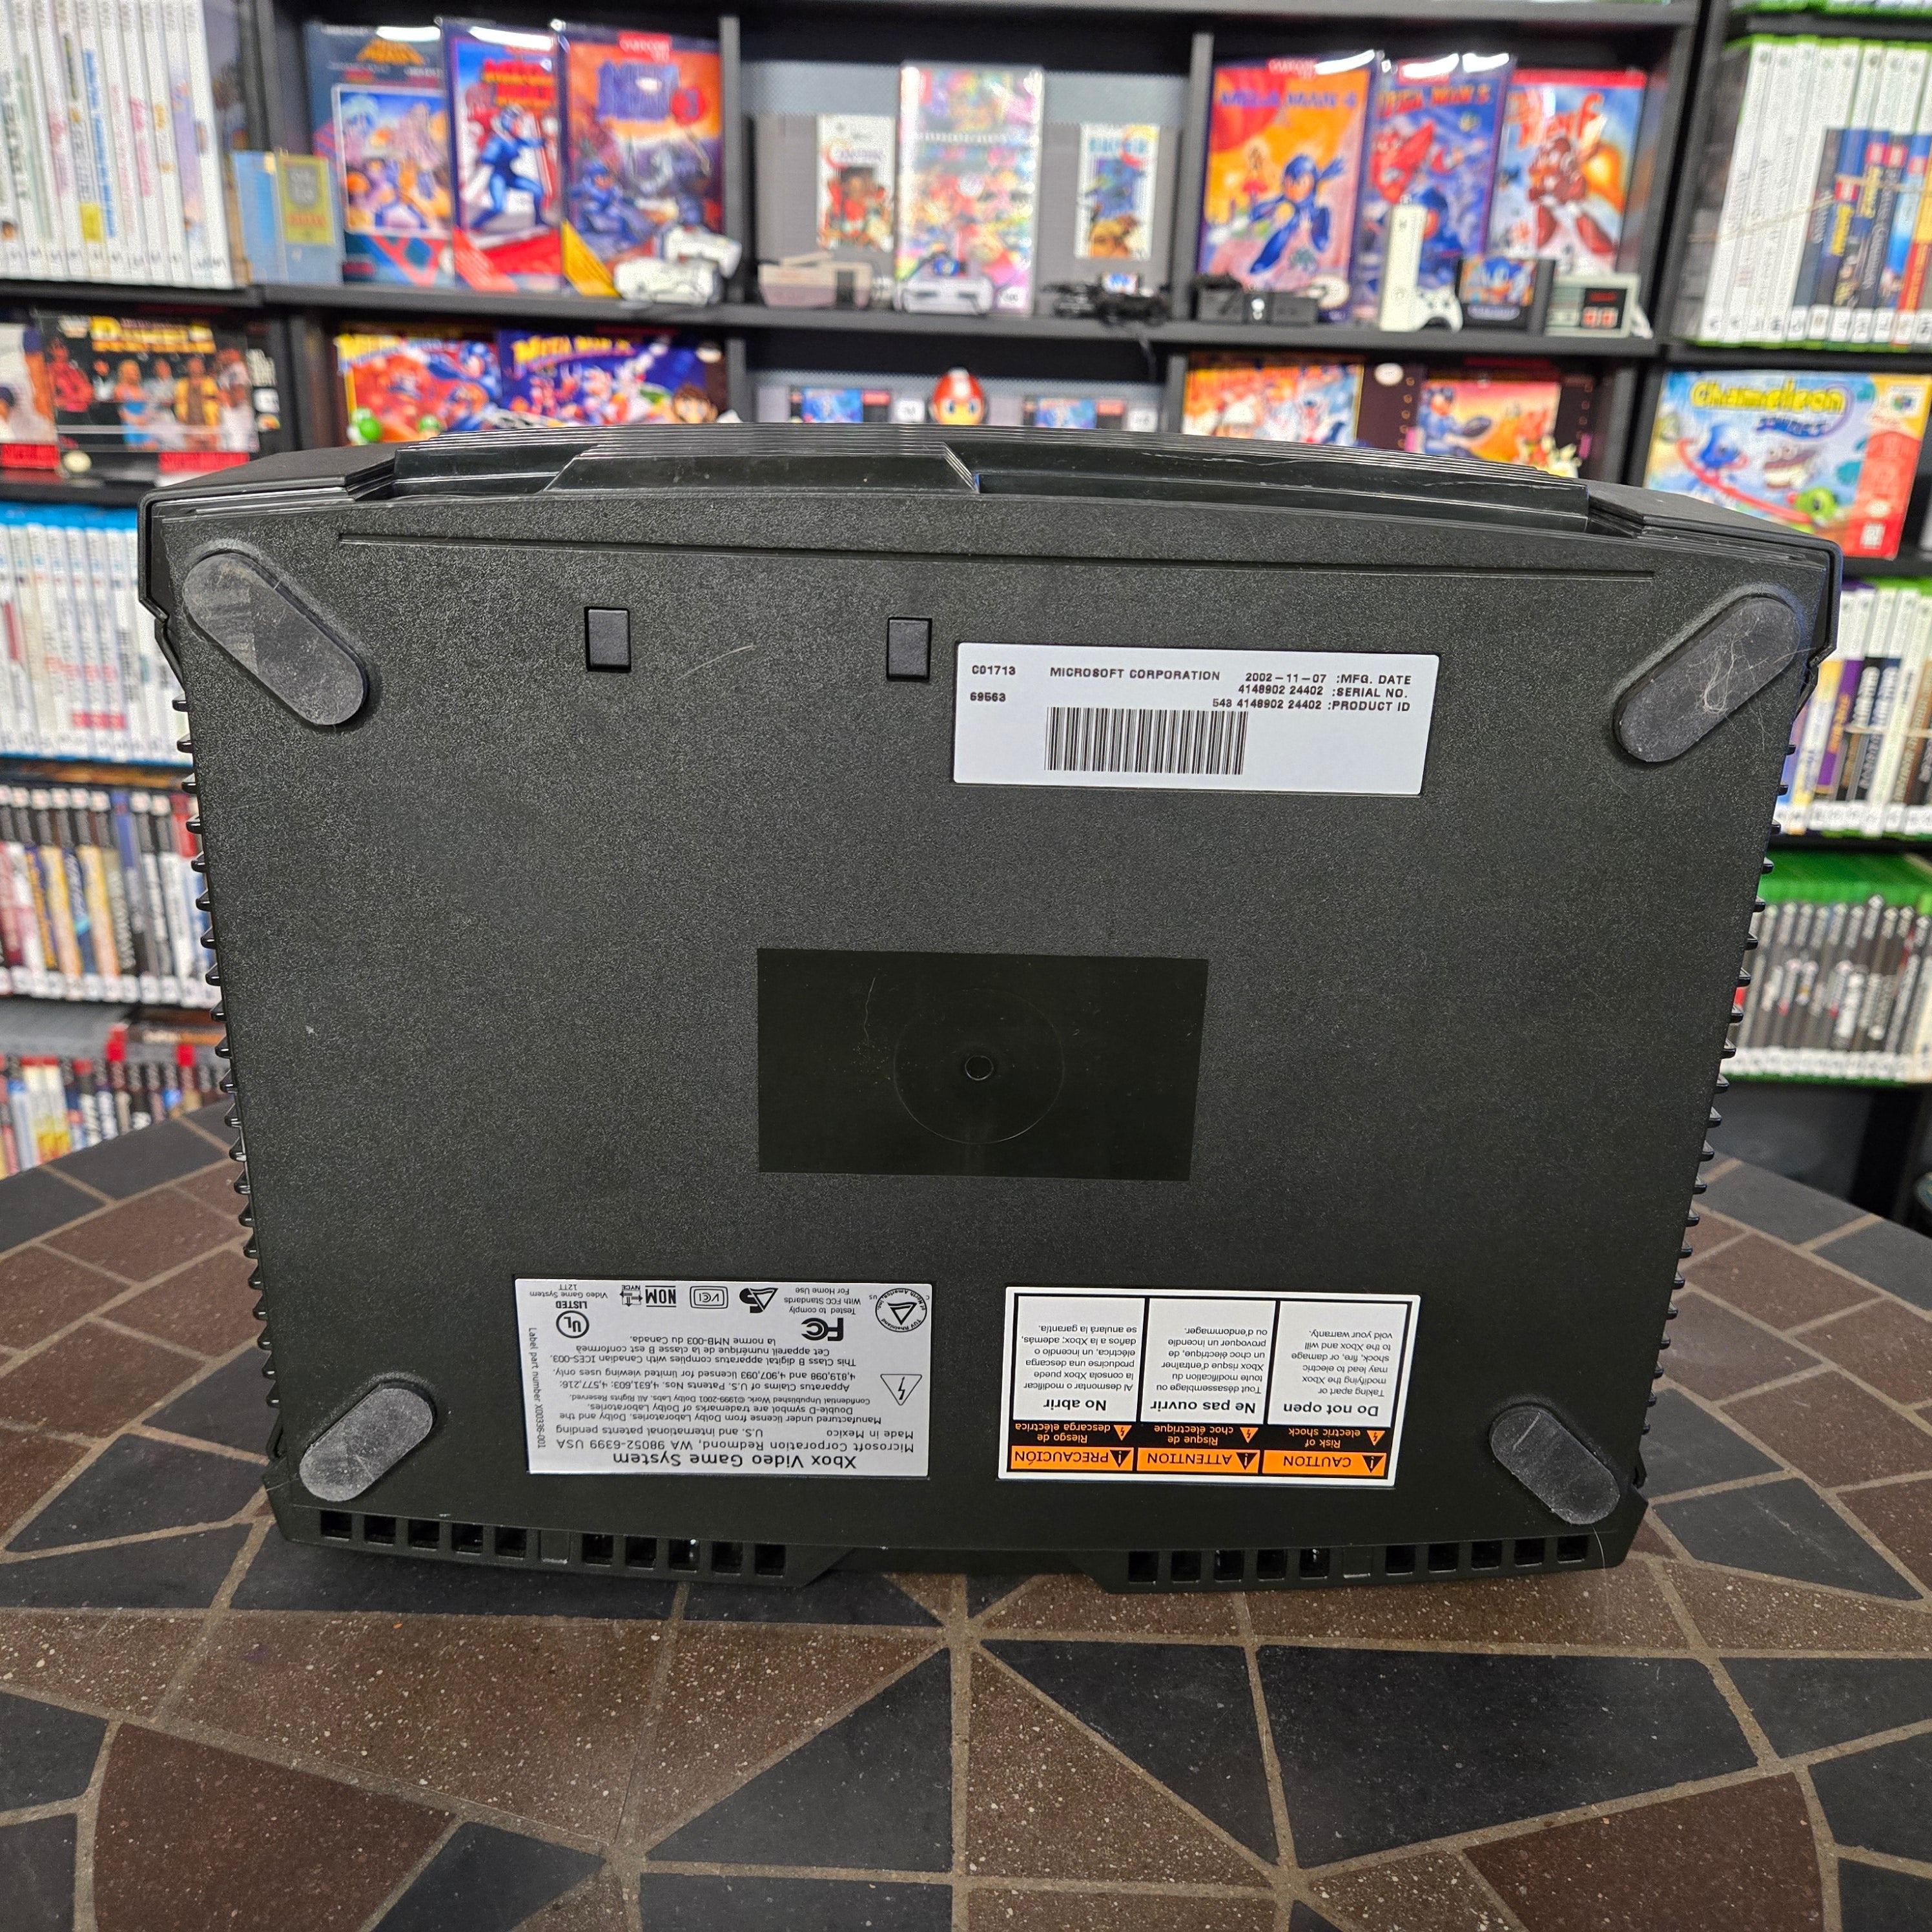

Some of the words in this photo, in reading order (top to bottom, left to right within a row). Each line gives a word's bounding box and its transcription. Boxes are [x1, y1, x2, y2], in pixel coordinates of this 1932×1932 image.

[1690, 376, 1847, 412] Chameleon
[1050, 667, 1124, 678] MICROSOFT
[1129, 669, 1220, 681] CORPORATION
[1378, 675, 1412, 684] DATE
[1290, 685, 1323, 695] 24402
[1386, 688, 1407, 698] NO.
[1288, 699, 1322, 710] 24402
[1397, 702, 1410, 712] ID
[645, 1289, 677, 1304] NOM
[555, 1300, 588, 1309] LISTED
[564, 1317, 581, 1332] UL
[1185, 1326, 1253, 1337] d'endommager.
[1309, 1329, 1350, 1338] warranty.
[529, 1328, 539, 1349] Label
[630, 1336, 668, 1344] Canada.
[719, 1346, 768, 1356] numérique
[772, 1347, 810, 1355] appareil
[1182, 1350, 1228, 1359] électrique,
[1291, 1351, 1328, 1361] damage
[529, 1351, 539, 1368] part
[670, 1355, 712, 1364] complies
[715, 1355, 763, 1364] apparatus
[766, 1356, 795, 1366] digital
[808, 1358, 834, 1366] Class
[1342, 1353, 1358, 1362] fire,
[1361, 1355, 1390, 1363] shock,
[1161, 1362, 1209, 1370] d'entraîner
[1211, 1361, 1238, 1371] risque
[1344, 1376, 1386, 1385] modifying
[533, 1371, 541, 1402] number
[1170, 1383, 1239, 1393] désassemblage
[1330, 1387, 1353, 1395] apart
[1355, 1387, 1384, 1397] Taking
[1043, 1399, 1080, 1411] abrir
[1085, 1400, 1106, 1411] No
[1150, 1401, 1197, 1412] ouvrir
[1203, 1400, 1230, 1410] pas
[1235, 1403, 1255, 1413] Ne
[1283, 1402, 1322, 1413] open
[1326, 1404, 1352, 1416] not
[1357, 1406, 1379, 1417] Do
[556, 1424, 598, 1435] pending
[602, 1426, 643, 1435] patents
[647, 1428, 714, 1437] international
[719, 1428, 738, 1437] and
[743, 1429, 763, 1437] U.S.
[1015, 1423, 1060, 1433] eléctrica
[1064, 1423, 1110, 1433] descarga
[1154, 1424, 1206, 1435] électrique
[1209, 1426, 1233, 1435] choc
[1289, 1428, 1319, 1437] shock
[827, 1430, 864, 1439] Mexico
[884, 1431, 913, 1439] Made
[1037, 1434, 1049, 1443] de
[1054, 1432, 1087, 1443] Riesgo
[1322, 1429, 1361, 1438] electric
[557, 1439, 584, 1449] USA
[590, 1440, 664, 1450] 98052-6399
[699, 1439, 763, 1451] Redmond,
[1167, 1436, 1180, 1444] de
[1184, 1435, 1218, 1446] Risque
[1319, 1439, 1341, 1448] Risk
[670, 1441, 693, 1450] WA
[770, 1441, 847, 1452] Corporation
[854, 1443, 913, 1453] Microsoft
[613, 1450, 681, 1466] System
[689, 1454, 743, 1468] Game
[752, 1455, 805, 1468] Video
[812, 1455, 856, 1469] Xbox
[1015, 1451, 1109, 1465] PRECAUCIÓN
[1147, 1453, 1232, 1465] ATTENTION
[1284, 1455, 1351, 1468] CAUTION
